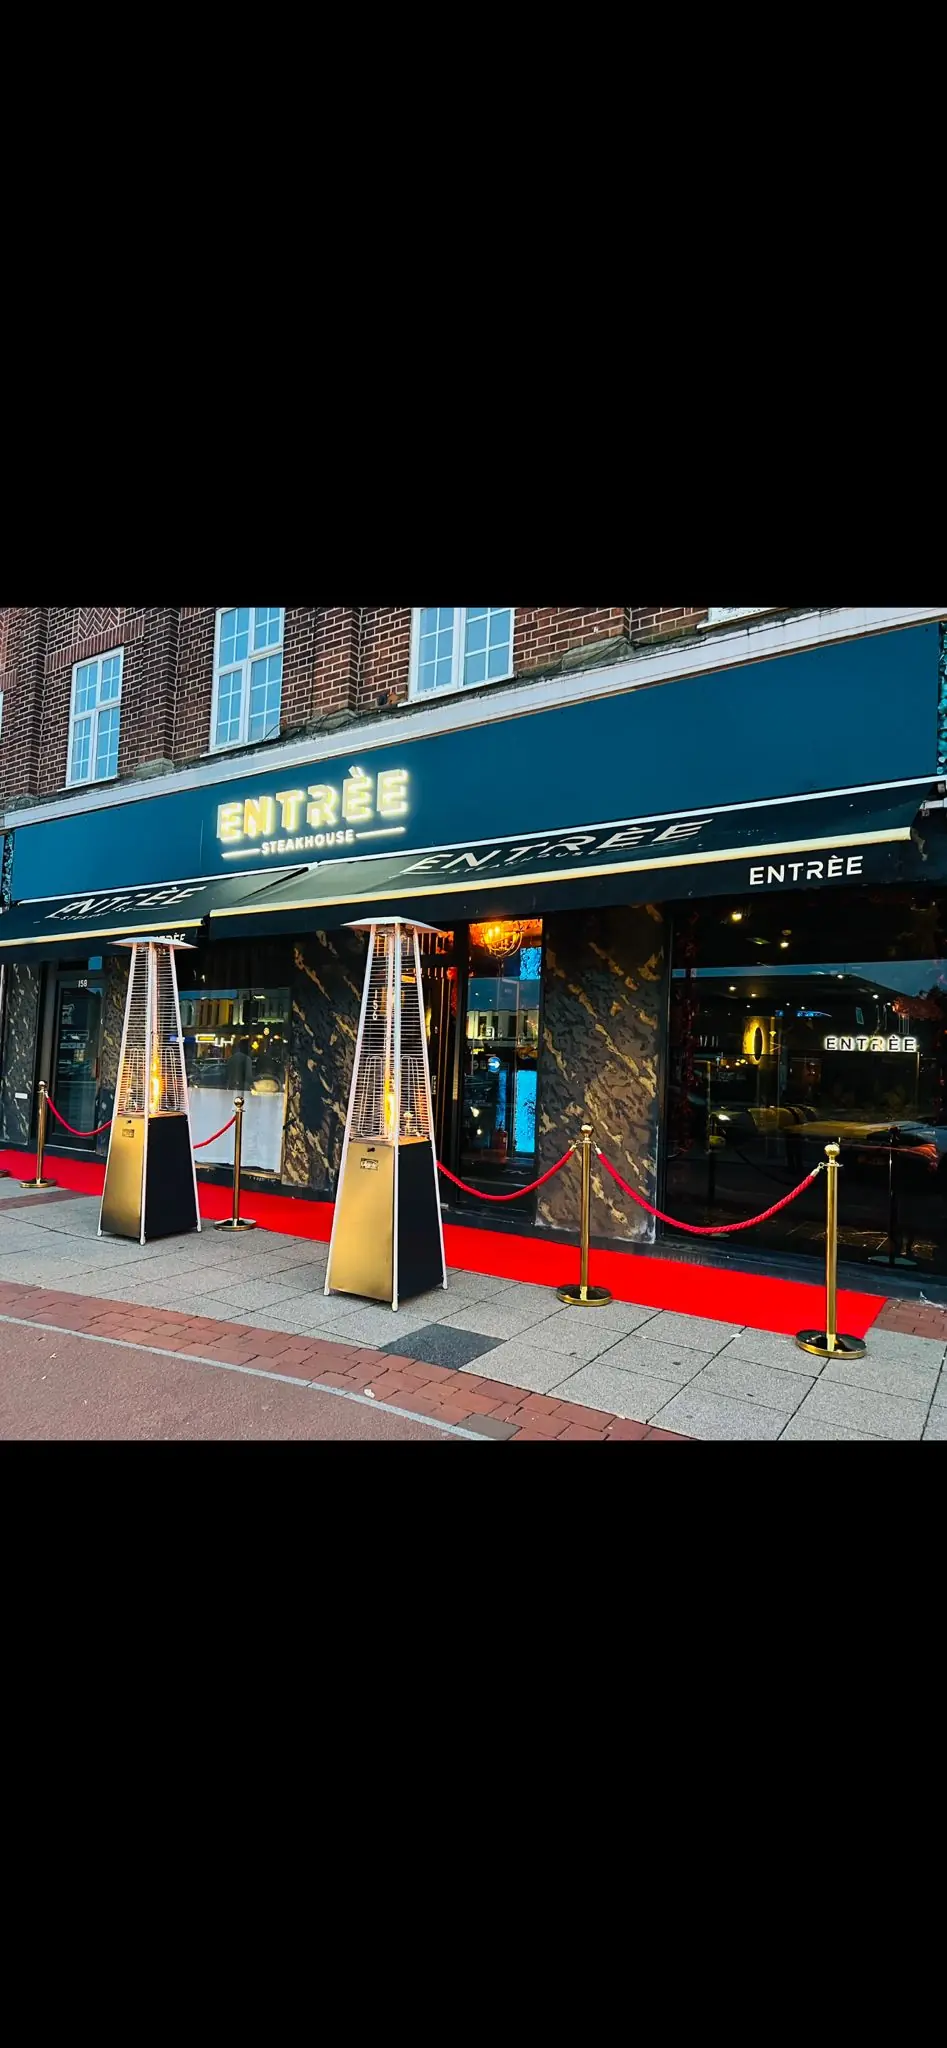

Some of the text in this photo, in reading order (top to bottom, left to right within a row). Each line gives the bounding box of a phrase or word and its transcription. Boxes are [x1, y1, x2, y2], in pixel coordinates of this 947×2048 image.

[217, 766, 408, 843] ENTRÈE
[261, 829, 356, 856] STEAKHOUSE
[400, 818, 713, 874] ENTRÈE
[749, 855, 864, 885] ENTRÈE
[824, 1034, 917, 1052] ENTRÈE
